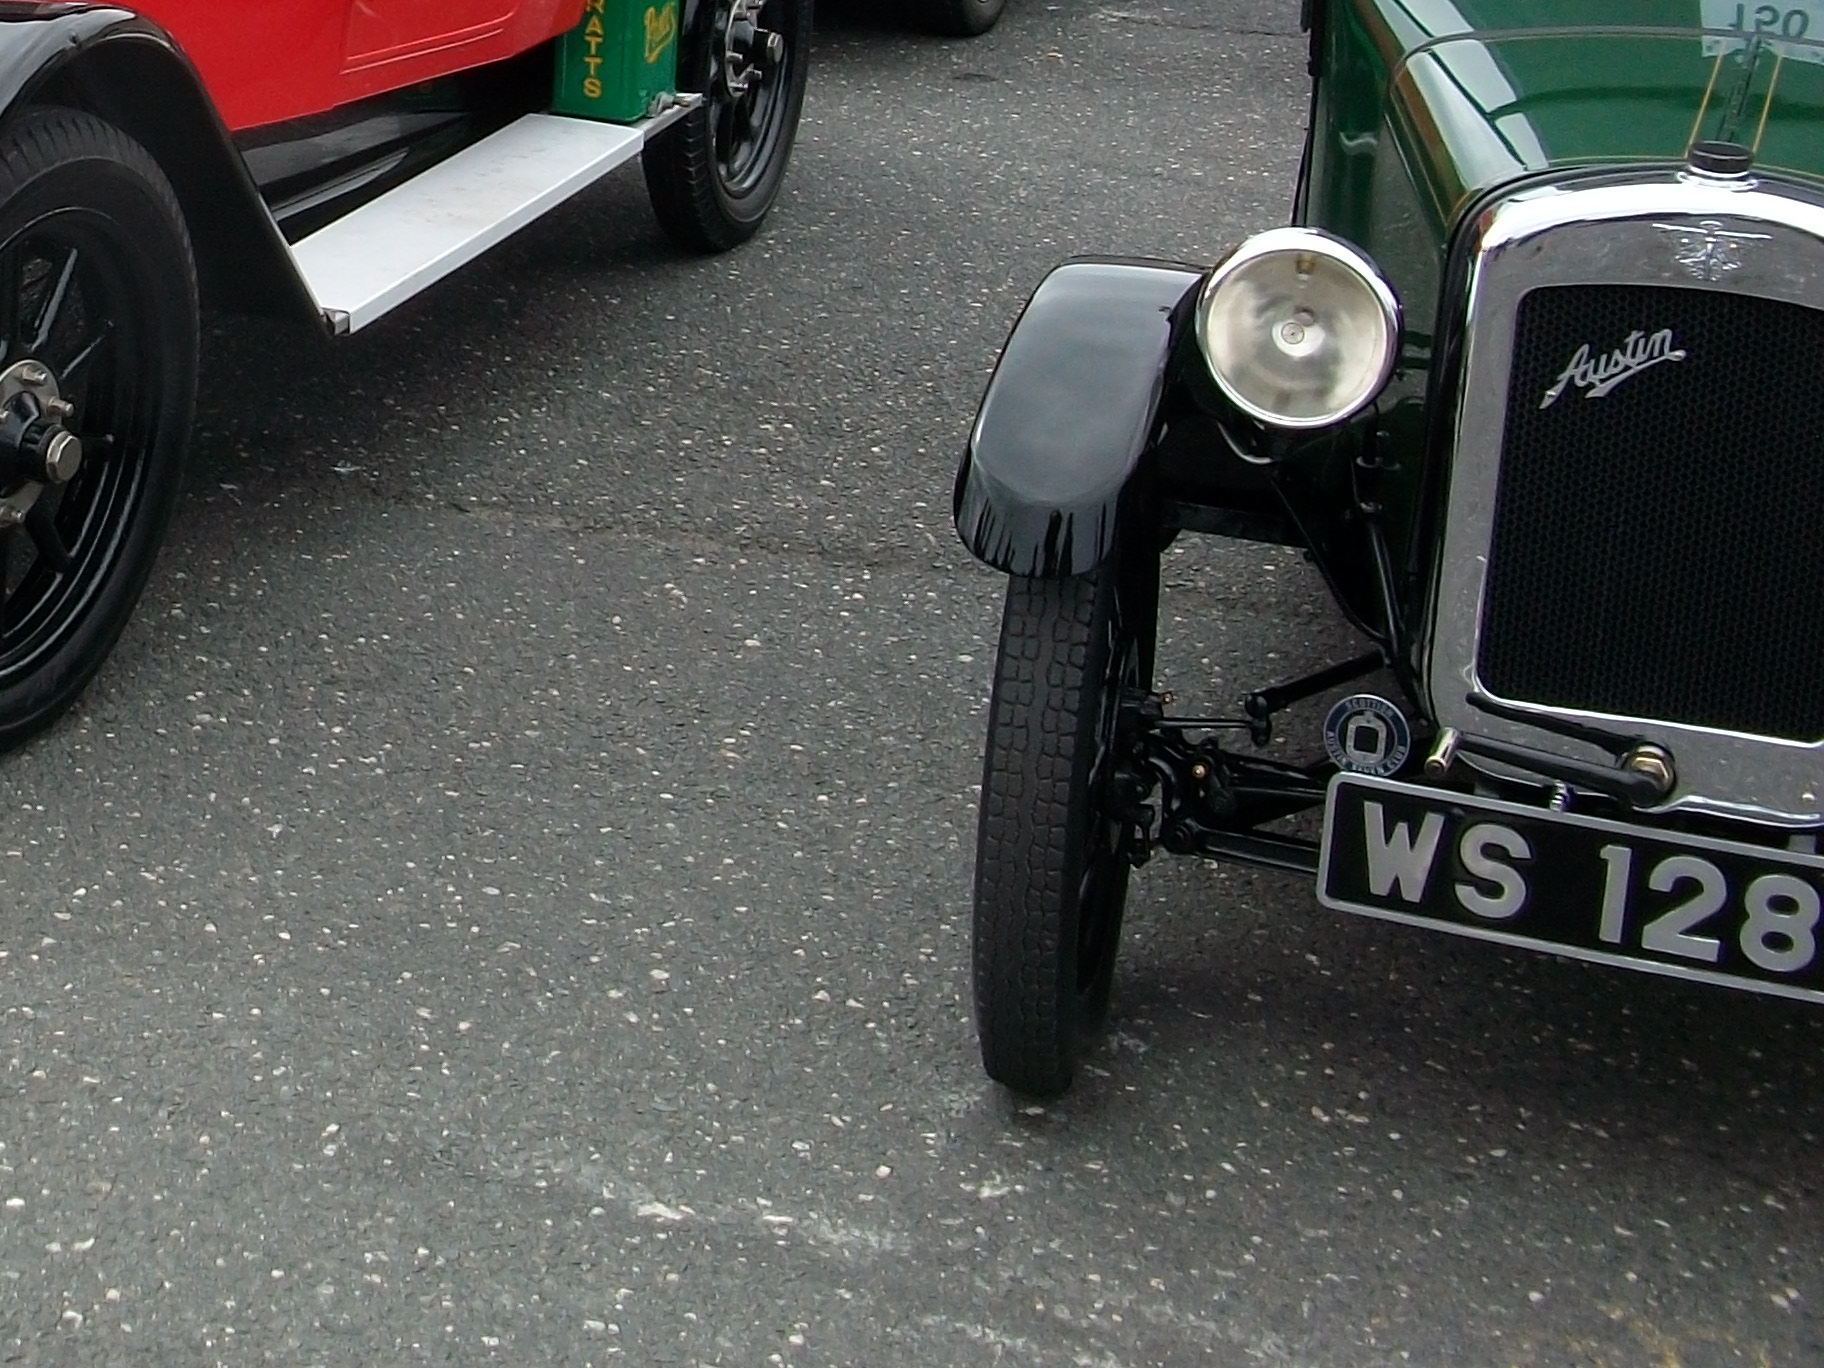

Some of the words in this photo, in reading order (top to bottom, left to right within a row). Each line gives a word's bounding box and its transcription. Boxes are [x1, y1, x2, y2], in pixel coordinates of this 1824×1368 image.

[1538, 328, 1687, 410] Austin
[1363, 800, 1533, 919] WS
[1598, 844, 1821, 973] 128
